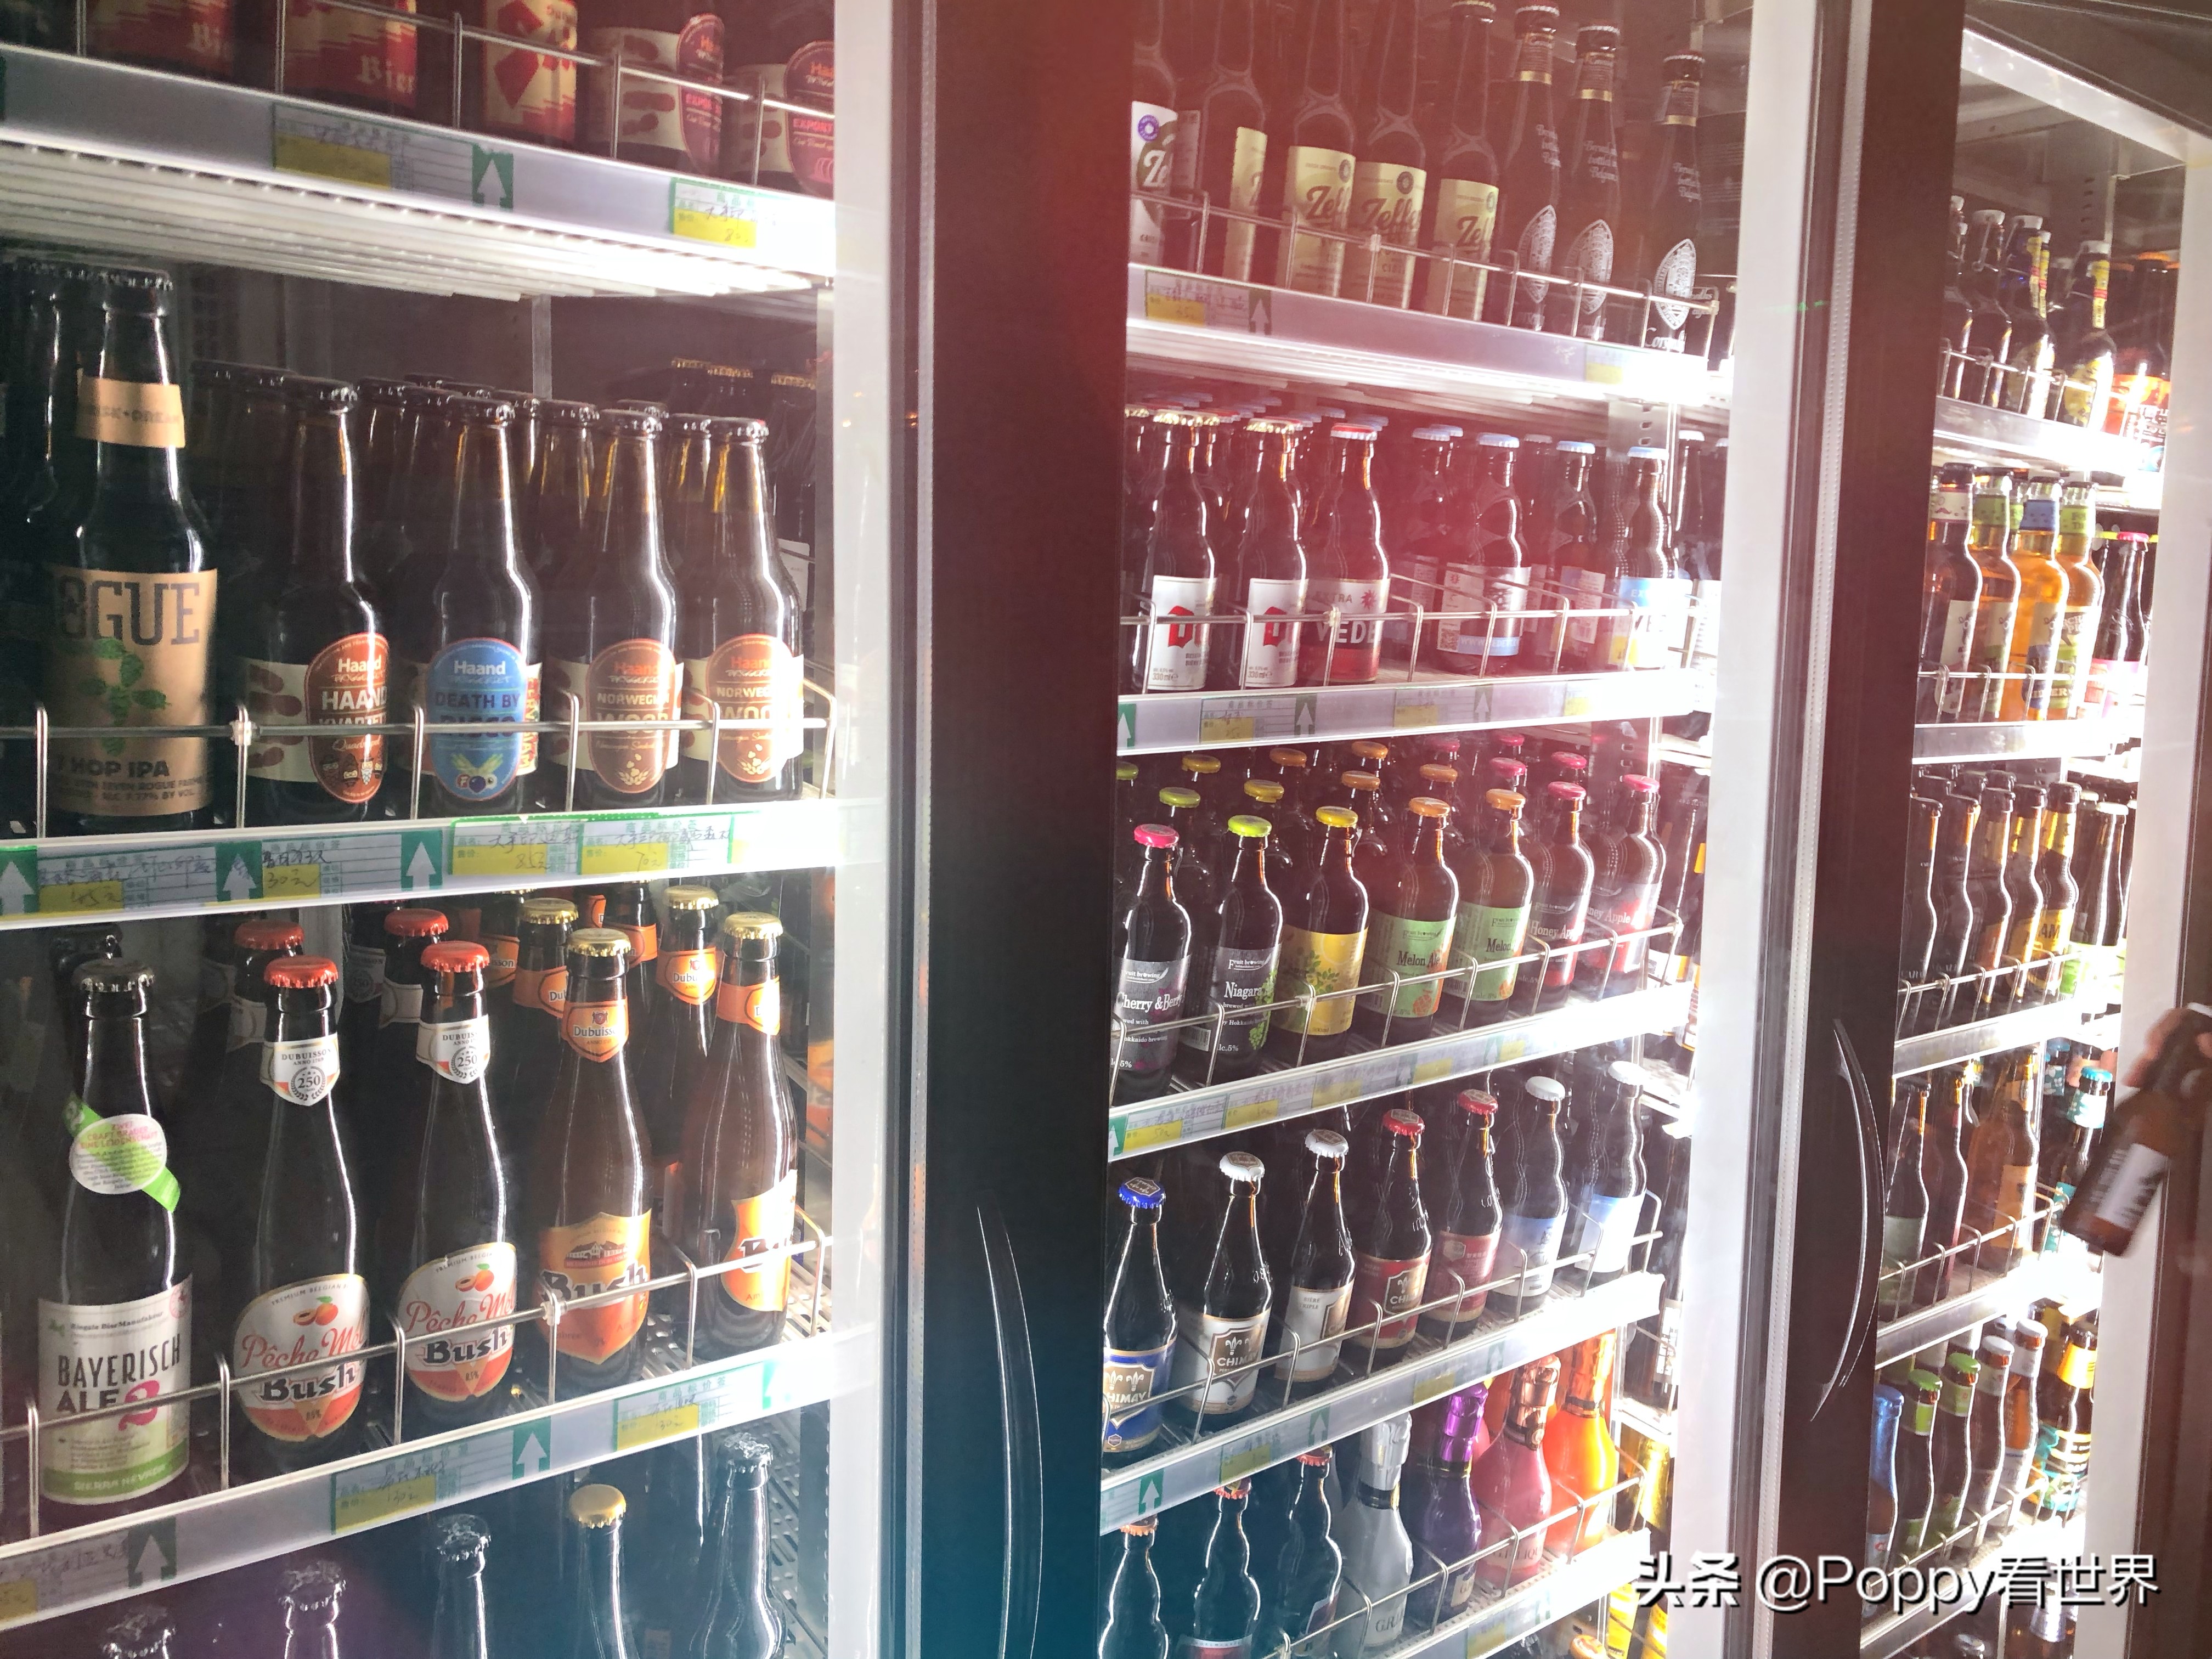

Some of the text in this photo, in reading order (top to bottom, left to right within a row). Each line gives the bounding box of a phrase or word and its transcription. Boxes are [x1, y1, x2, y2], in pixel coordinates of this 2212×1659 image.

[59, 582, 200, 646] OGUE
[1317, 620, 1381, 644] VEDE
[338, 654, 382, 673] Haad
[454, 661, 506, 675] Haand
[731, 657, 770, 670] Haan
[321, 686, 387, 711] HAAND
[435, 692, 521, 709] DEATH BY
[716, 685, 770, 698] NORWEG
[128, 760, 170, 778] IPA
[1588, 907, 1632, 924] ney Apple
[1530, 920, 1560, 939] Honey
[1486, 938, 1511, 952] Melon
[1228, 959, 1244, 969] Fruit
[1397, 950, 1426, 966] Melon
[1224, 981, 1262, 1000] Niagara
[1115, 991, 1153, 1013] Cherry
[442, 1032, 475, 1041] DUBUIS
[574, 1025, 615, 1037] Dubuiss
[457, 1054, 477, 1068] 250
[297, 1075, 321, 1089] 250
[436, 1252, 493, 1273] PREMIUM BELGIA
[272, 1289, 306, 1306] PREMIUM
[405, 1300, 477, 1333] Pêche
[241, 1334, 319, 1369] Pêche
[424, 1328, 507, 1364] Bush
[58, 1334, 181, 1389] BAYERISCH
[259, 1362, 356, 1401] Bush
